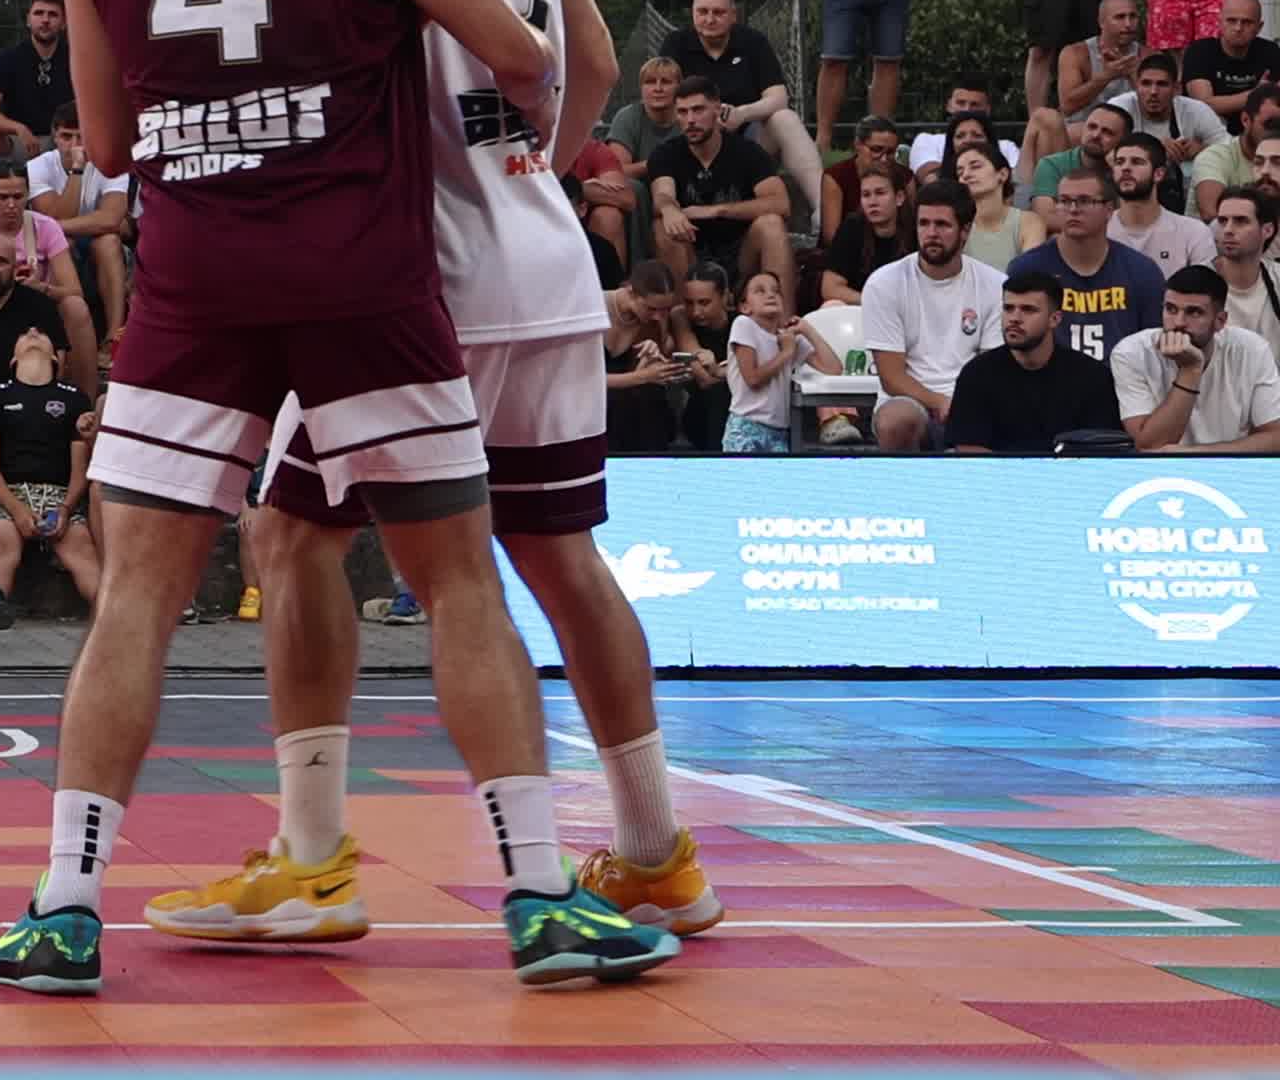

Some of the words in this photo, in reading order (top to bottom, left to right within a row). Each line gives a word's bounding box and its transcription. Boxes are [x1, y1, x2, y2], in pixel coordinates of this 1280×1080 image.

[131, 82, 333, 162] BULUT
[161, 153, 265, 182] HOOPS
[1061, 286, 1128, 313] ENVER
[1070, 323, 1104, 361] 15
[738, 518, 925, 540] НОВОСАДСКИ
[1087, 526, 1188, 553] НОВИ
[1191, 526, 1269, 553] САД
[740, 544, 936, 567] ОМЛАДИНСКИ
[742, 569, 840, 591] ФОРУМ
[1119, 559, 1241, 578] ЕВРОПСКИ
[1108, 581, 1168, 600] ГРАД
[1168, 581, 1260, 598] СПОРТА
